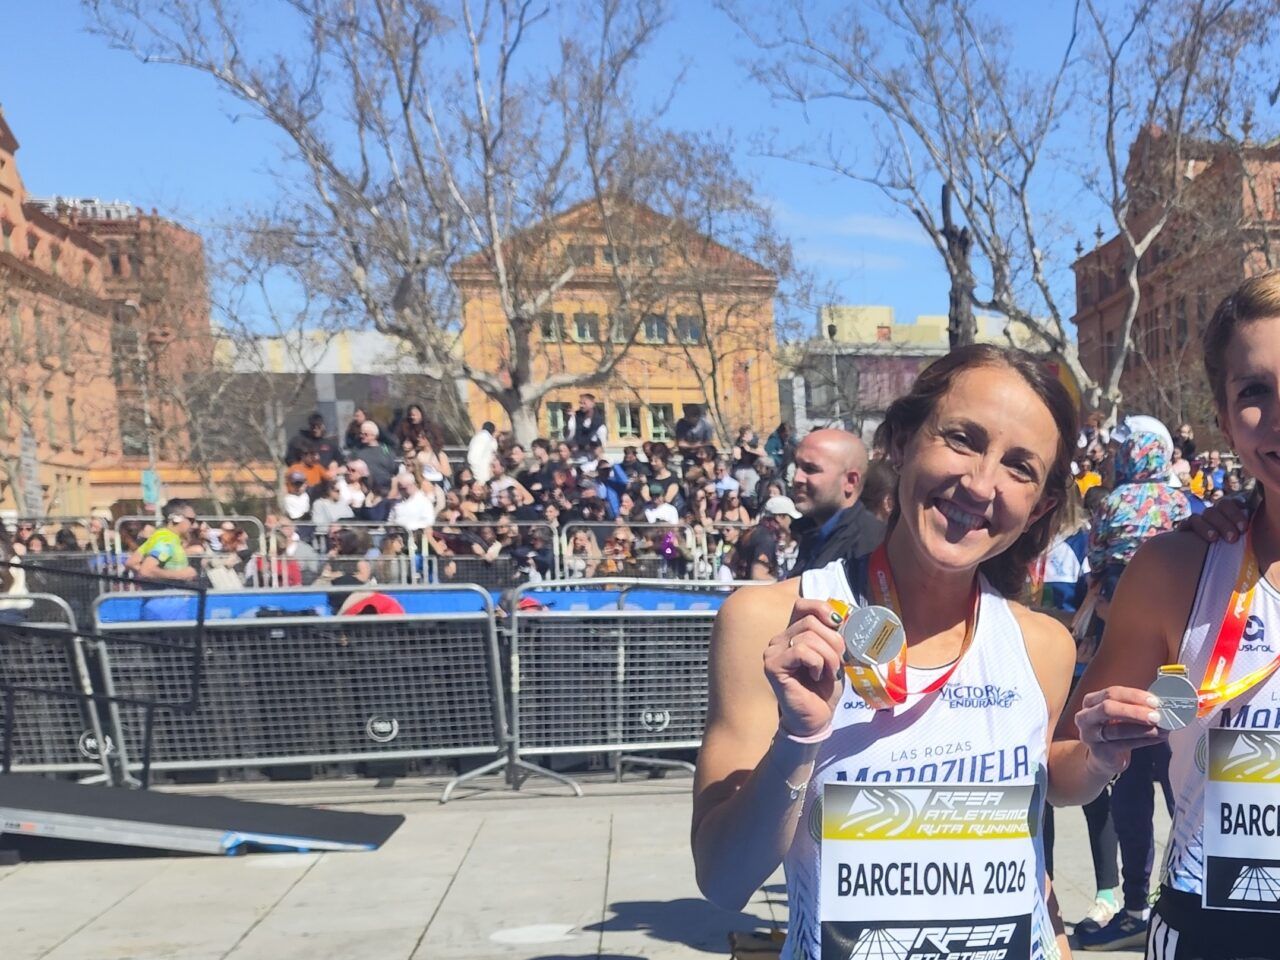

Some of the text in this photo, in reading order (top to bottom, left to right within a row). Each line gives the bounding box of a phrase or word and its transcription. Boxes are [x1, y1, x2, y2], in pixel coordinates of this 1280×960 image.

[940, 685, 1001, 700] VICTORY
[949, 697, 1010, 709] ENDURANCE
[891, 741, 972, 762] LAS ROZAS
[930, 791, 1005, 809] RFEA
[924, 808, 1028, 821] ATLETISMO
[917, 822, 1029, 835] RUTA RUNNING
[837, 859, 1026, 897] BARCELONA 2026
[914, 922, 1017, 954] RFEA
